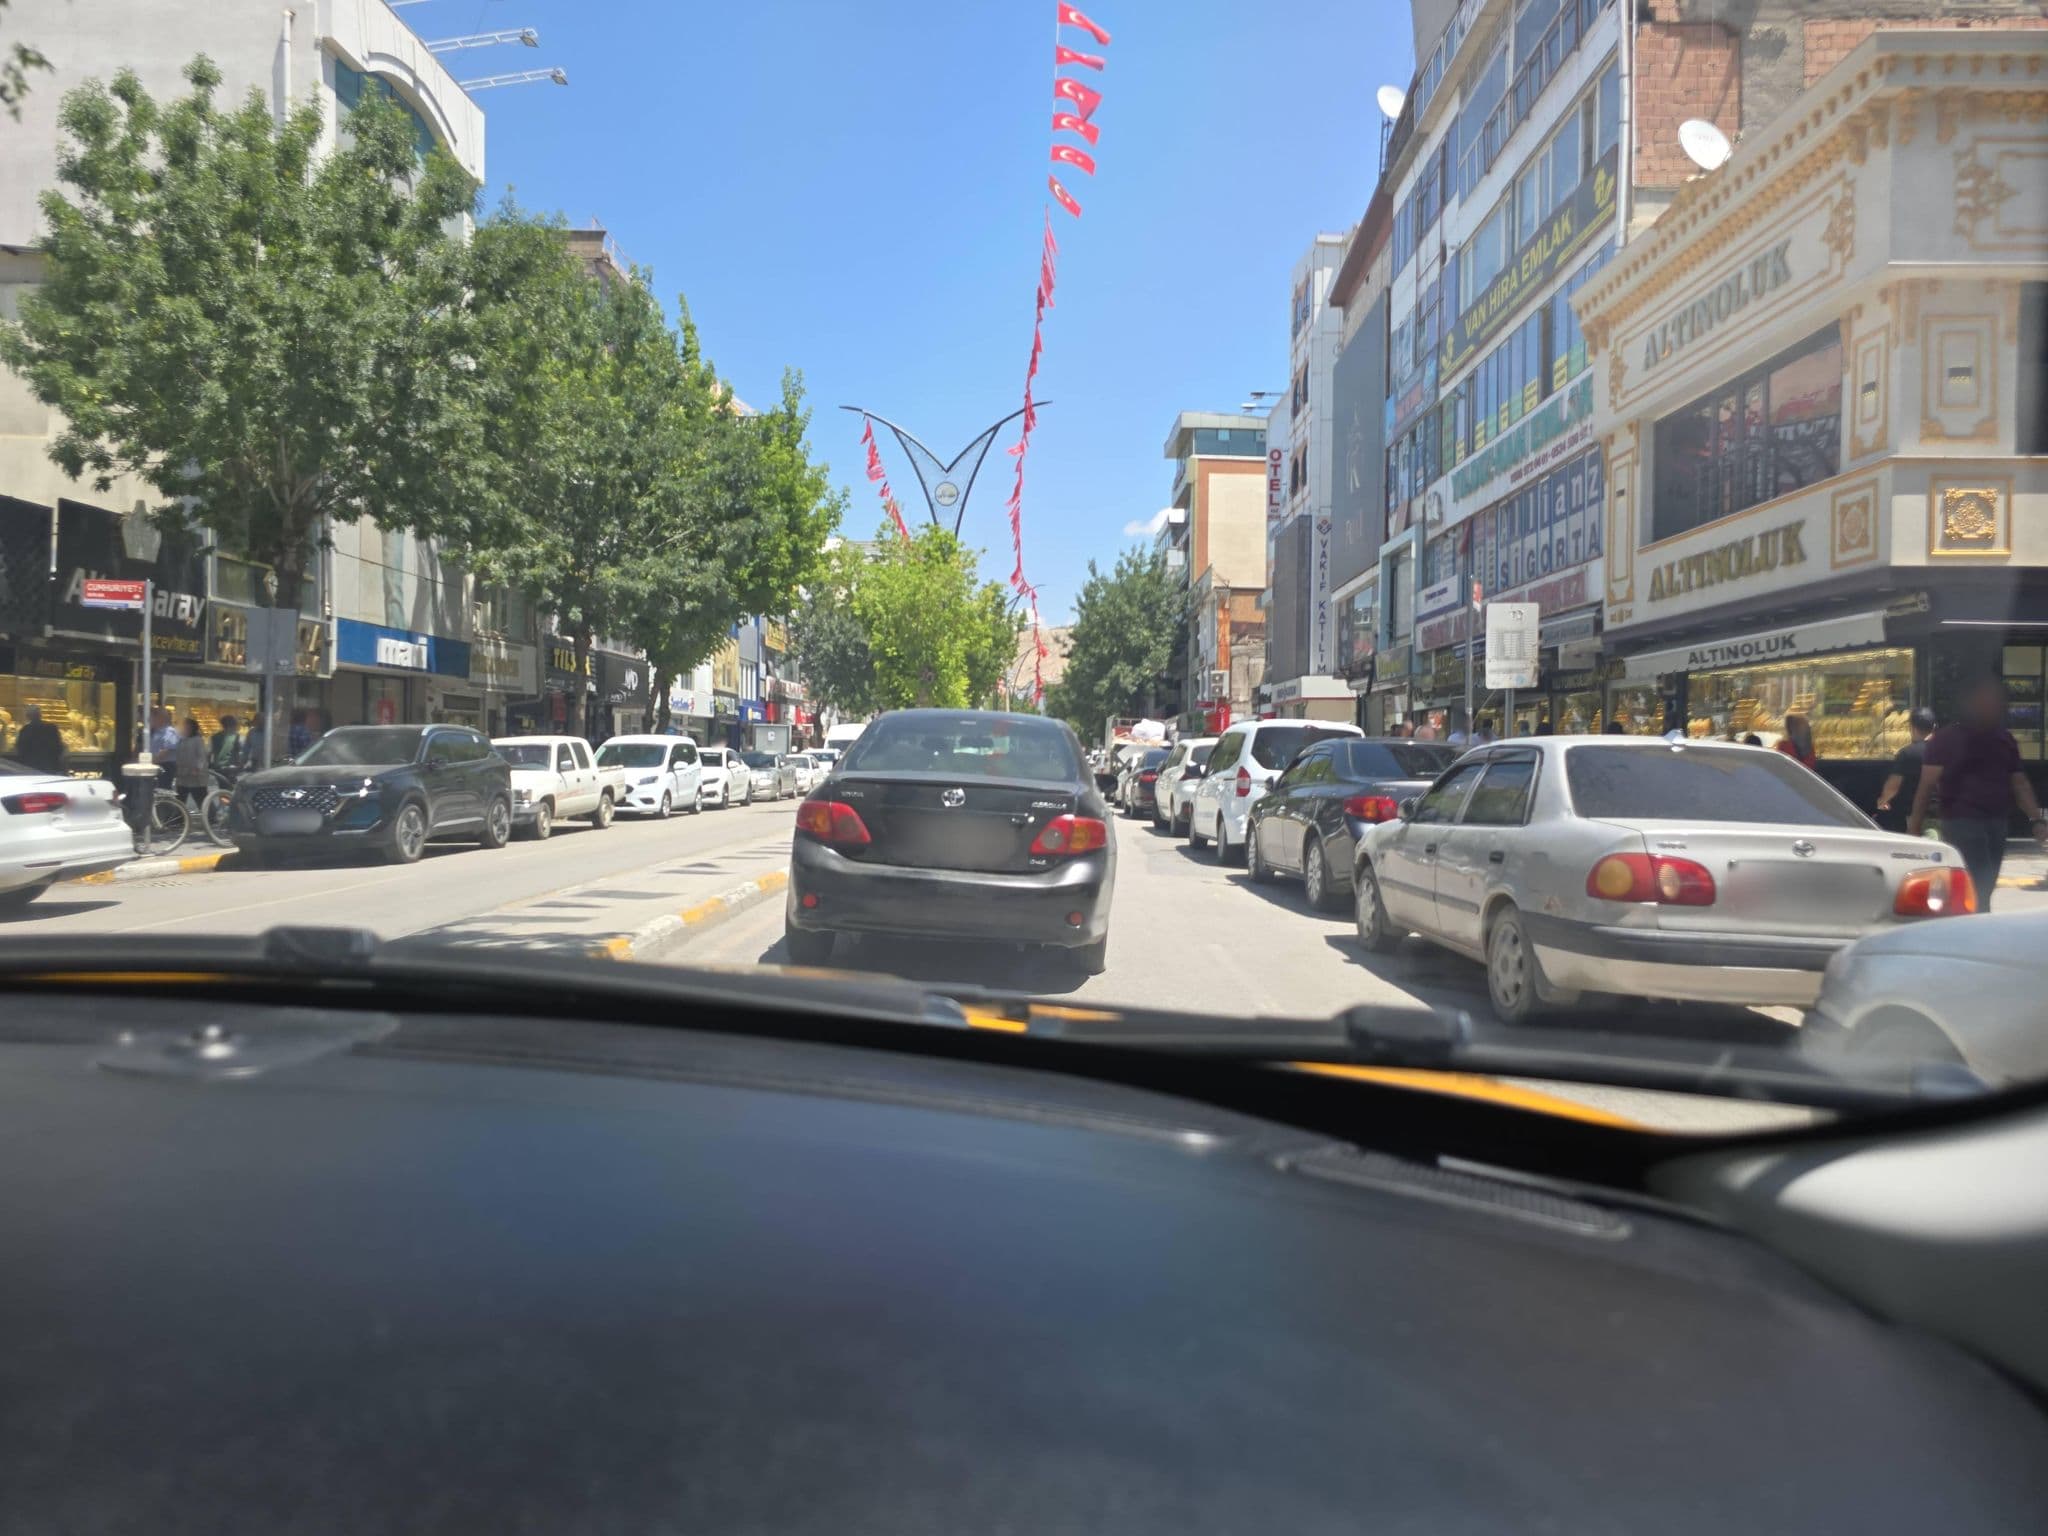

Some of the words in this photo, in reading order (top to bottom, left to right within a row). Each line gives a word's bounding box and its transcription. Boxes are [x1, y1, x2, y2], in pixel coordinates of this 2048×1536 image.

[1464, 300, 1487, 340] VAN
[1521, 208, 1572, 282] EMLAK
[1643, 238, 1792, 371] ALTINOLUK
[1269, 448, 1282, 506] OTEL
[1320, 539, 1328, 592] VAKIF
[1648, 519, 1807, 602] ALTINOLUK
[1316, 600, 1328, 674] KATILIM
[1688, 633, 1797, 665] ALTINOLUK
